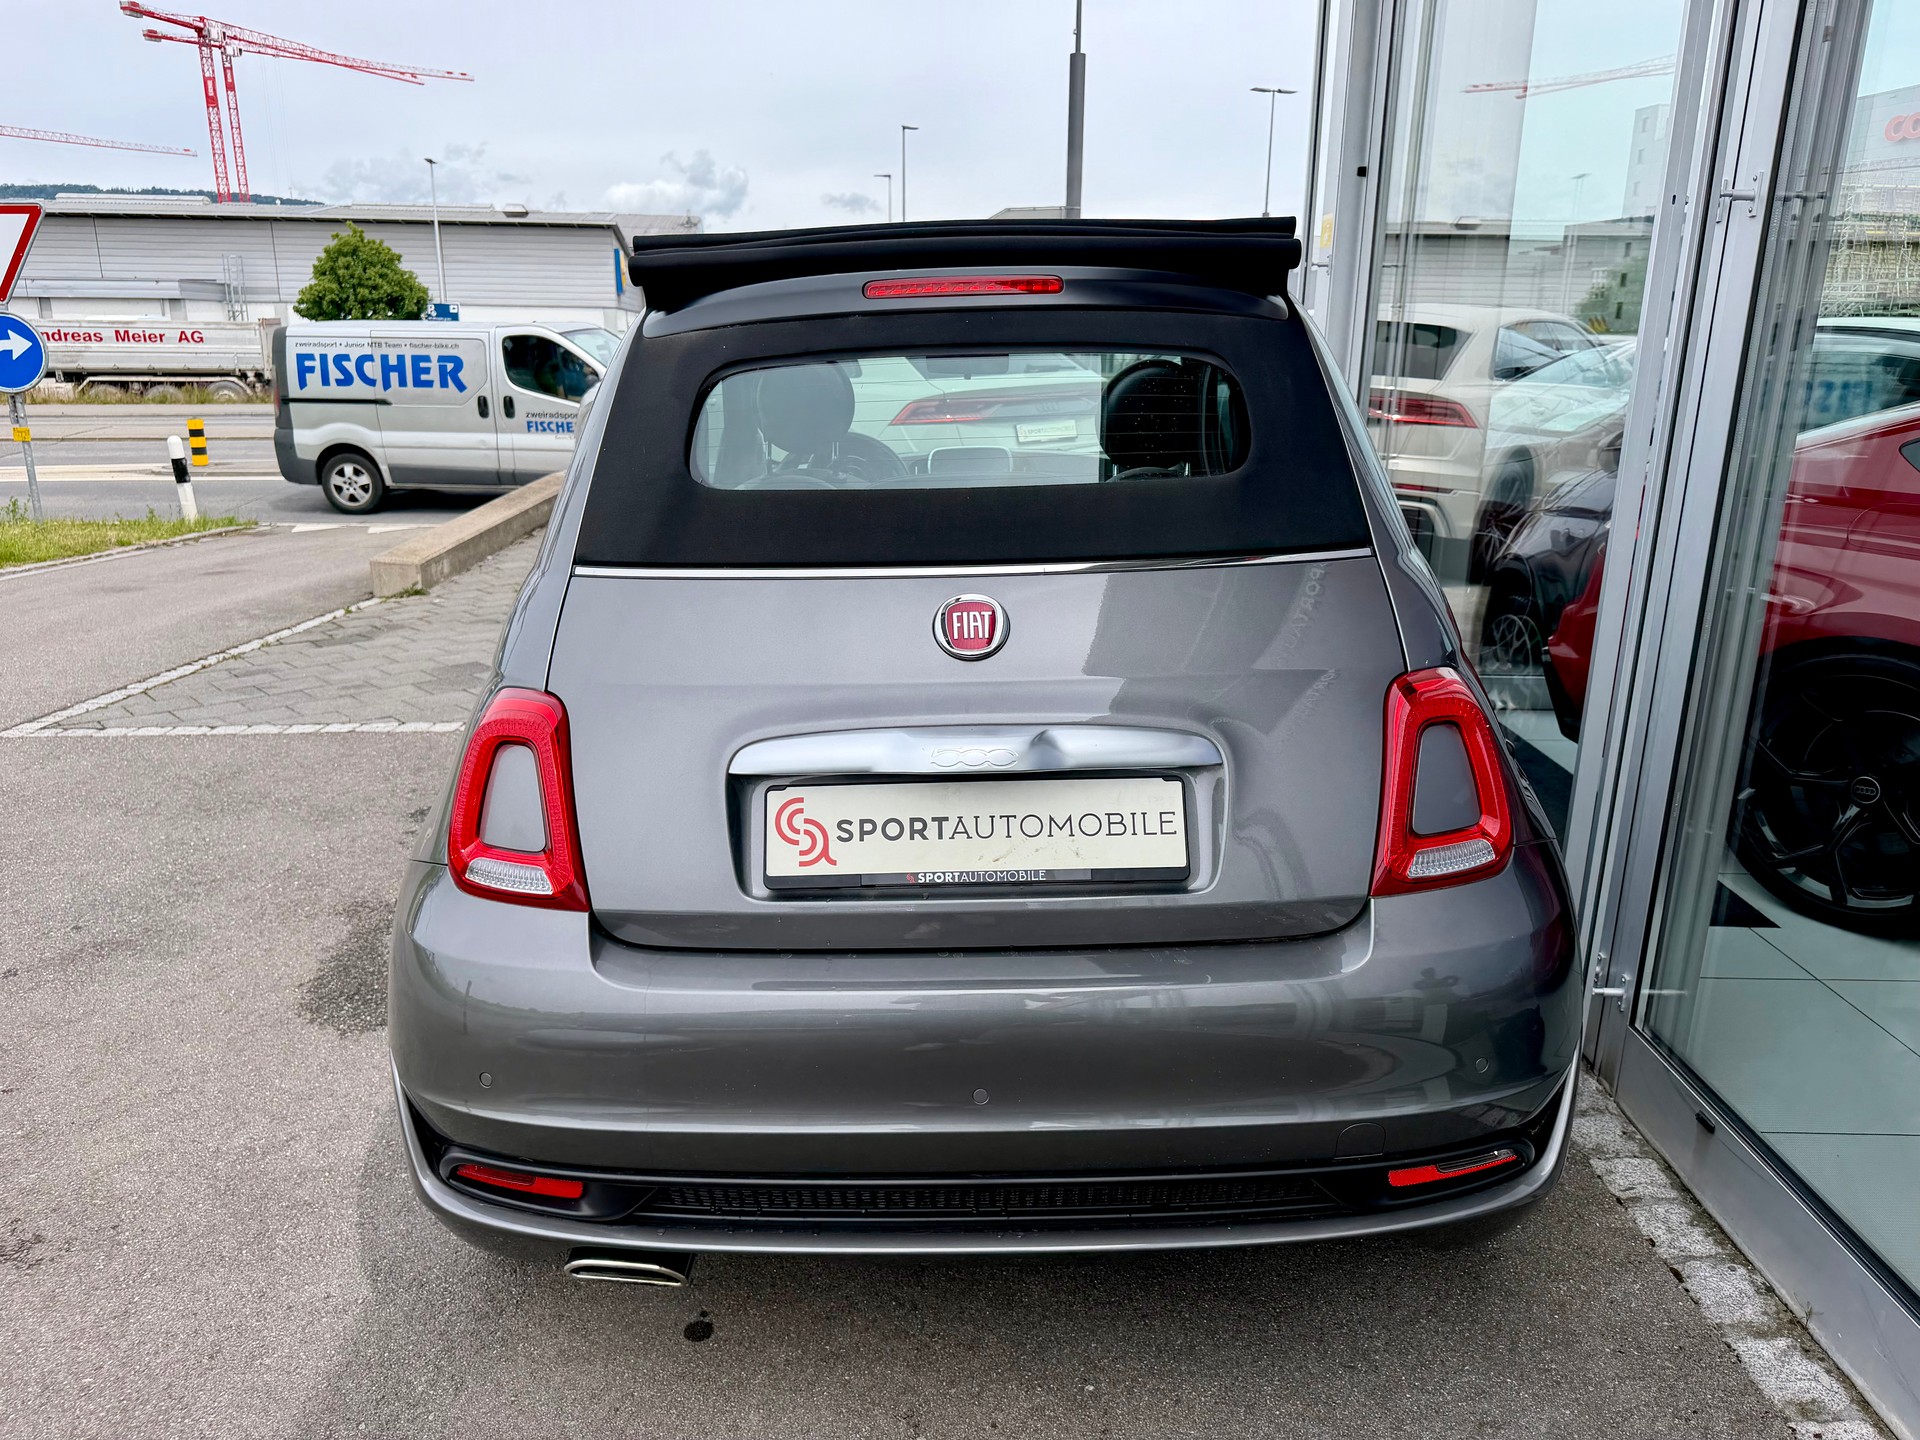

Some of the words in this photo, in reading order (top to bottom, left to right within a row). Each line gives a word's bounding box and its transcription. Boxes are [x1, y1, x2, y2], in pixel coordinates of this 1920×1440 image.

[40, 329, 103, 342] ndreas
[114, 329, 165, 343] Meier
[178, 330, 204, 343] AG
[296, 353, 467, 393] FISCHER
[525, 411, 578, 420] zweiradspor
[526, 421, 576, 433] FISCHE
[952, 611, 992, 640] FIAT
[930, 747, 1018, 768] 500
[836, 811, 1177, 843] SPORTAUTOMOBILE
[917, 870, 1046, 884] SPORTAUTOMOBILE
